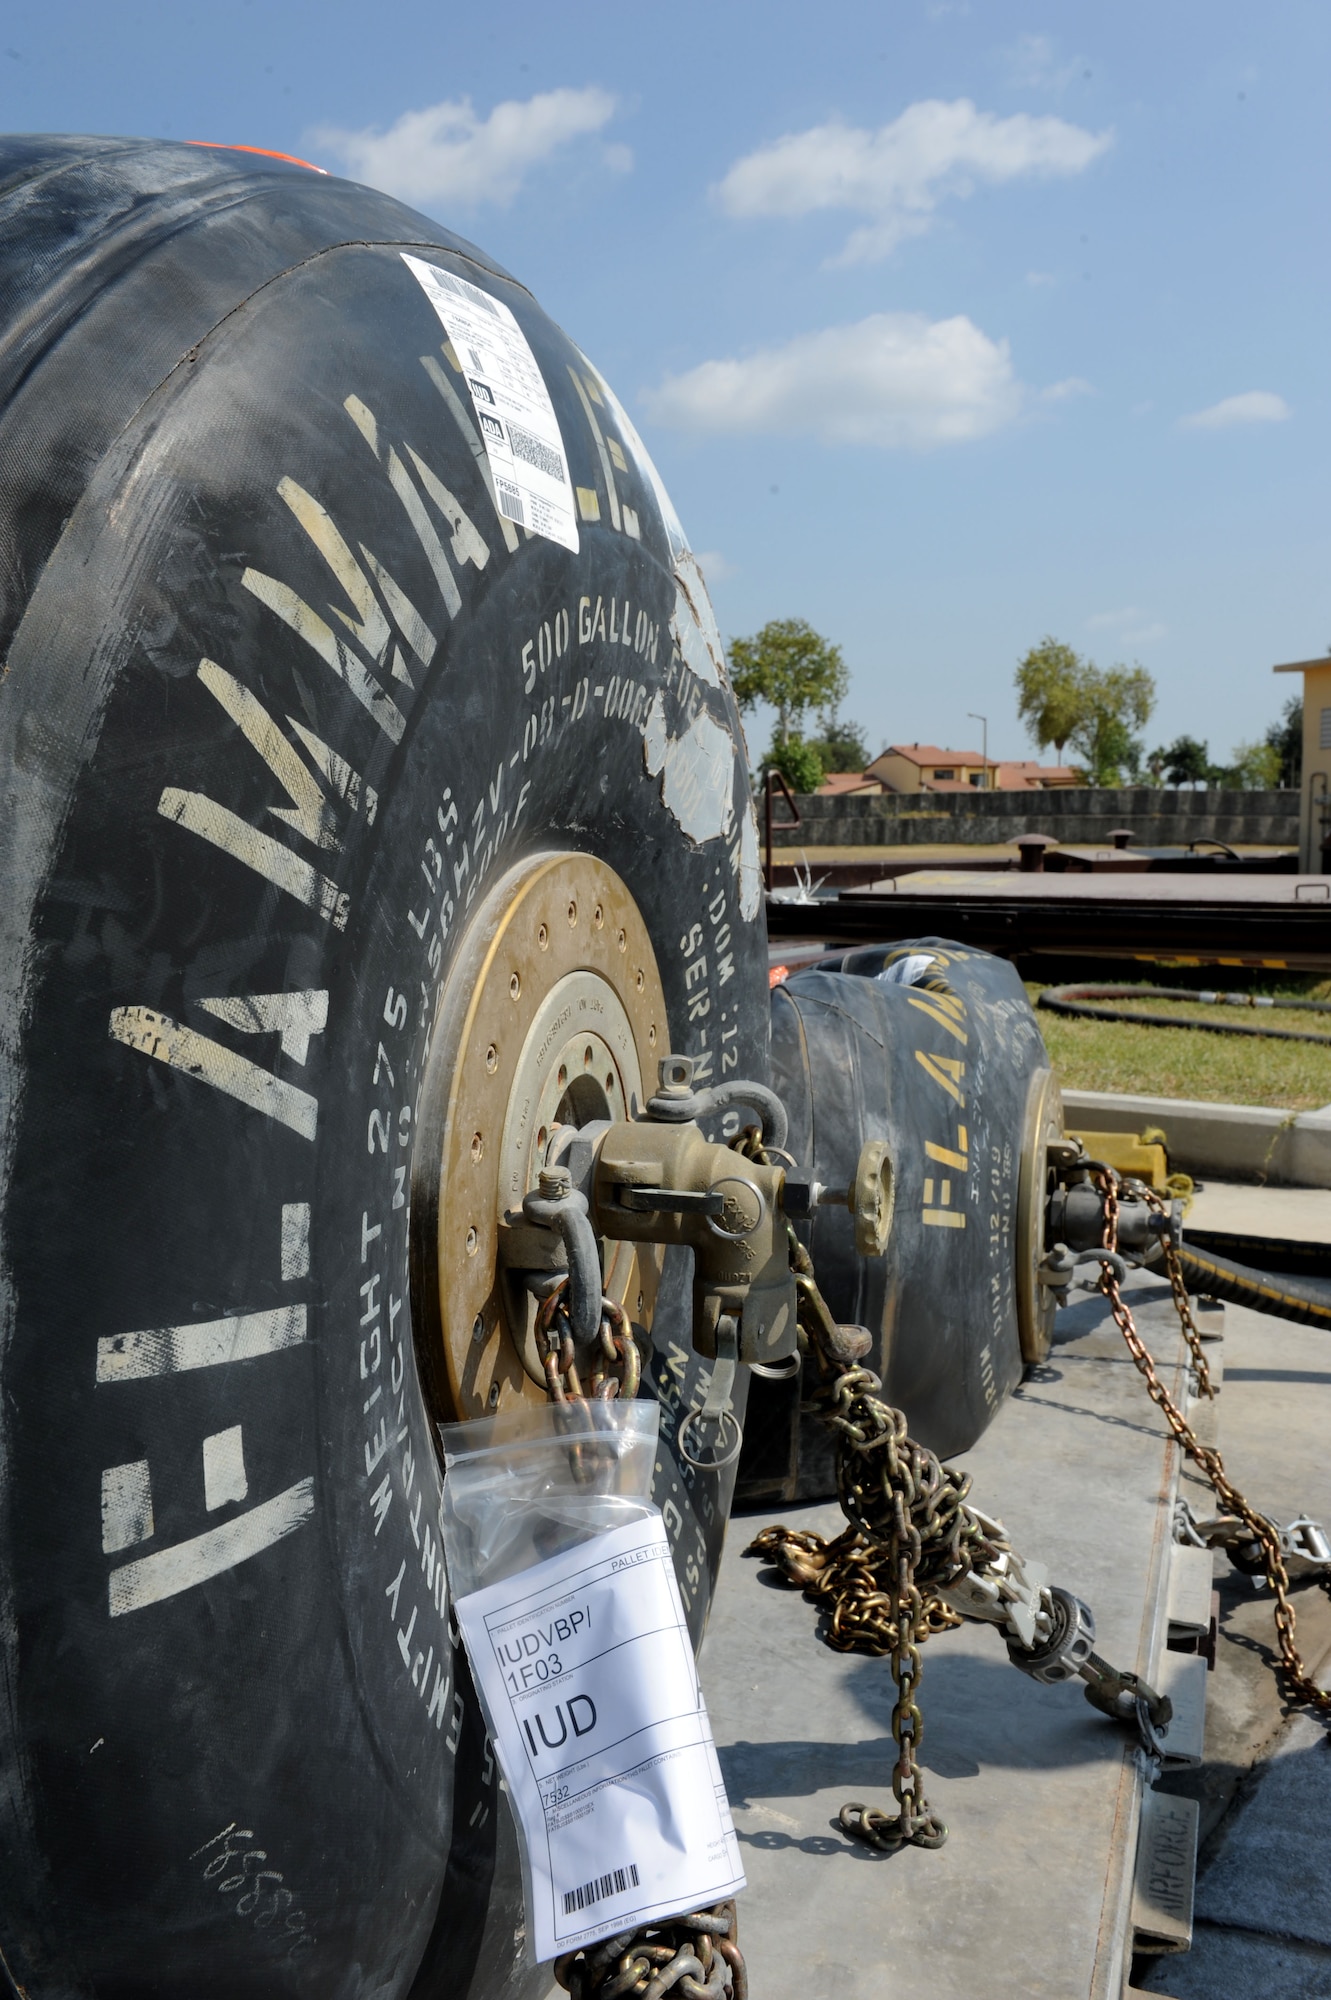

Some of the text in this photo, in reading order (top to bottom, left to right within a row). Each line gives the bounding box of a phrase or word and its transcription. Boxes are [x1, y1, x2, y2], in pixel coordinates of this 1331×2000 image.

[472, 384, 490, 402] IUD
[483, 417, 501, 437] ADA
[521, 607, 569, 695] 500
[578, 595, 660, 664] GALLON
[667, 646, 702, 722] FUE
[407, 787, 458, 940] LBS
[709, 888, 736, 987] DOM
[96, 338, 641, 1617] FLAMMAE
[367, 985, 408, 1154] 275
[359, 1211, 394, 1537] WEIGHT
[611, 1548, 650, 1571] PALLET
[680, 1525, 708, 1613] PSI
[517, 1605, 555, 1627] IDENTIFICATION
[554, 1594, 576, 1608] NUMBER
[384, 1560, 466, 1757] EMPTY
[497, 1605, 591, 1668] IUDVBP/
[508, 1653, 563, 1692] 1F03
[518, 1682, 553, 1702] ORIGINATING
[551, 1674, 574, 1688] STATION
[523, 1694, 597, 1757] IUD
[543, 1785, 570, 1807] 7532
[556, 1768, 577, 1781] WEIGHT
[552, 1791, 593, 1813] MISCELLANEOUS
[556, 1941, 566, 1949] DD
[566, 1935, 583, 1945] FORM
[597, 1924, 610, 1934] SEP
